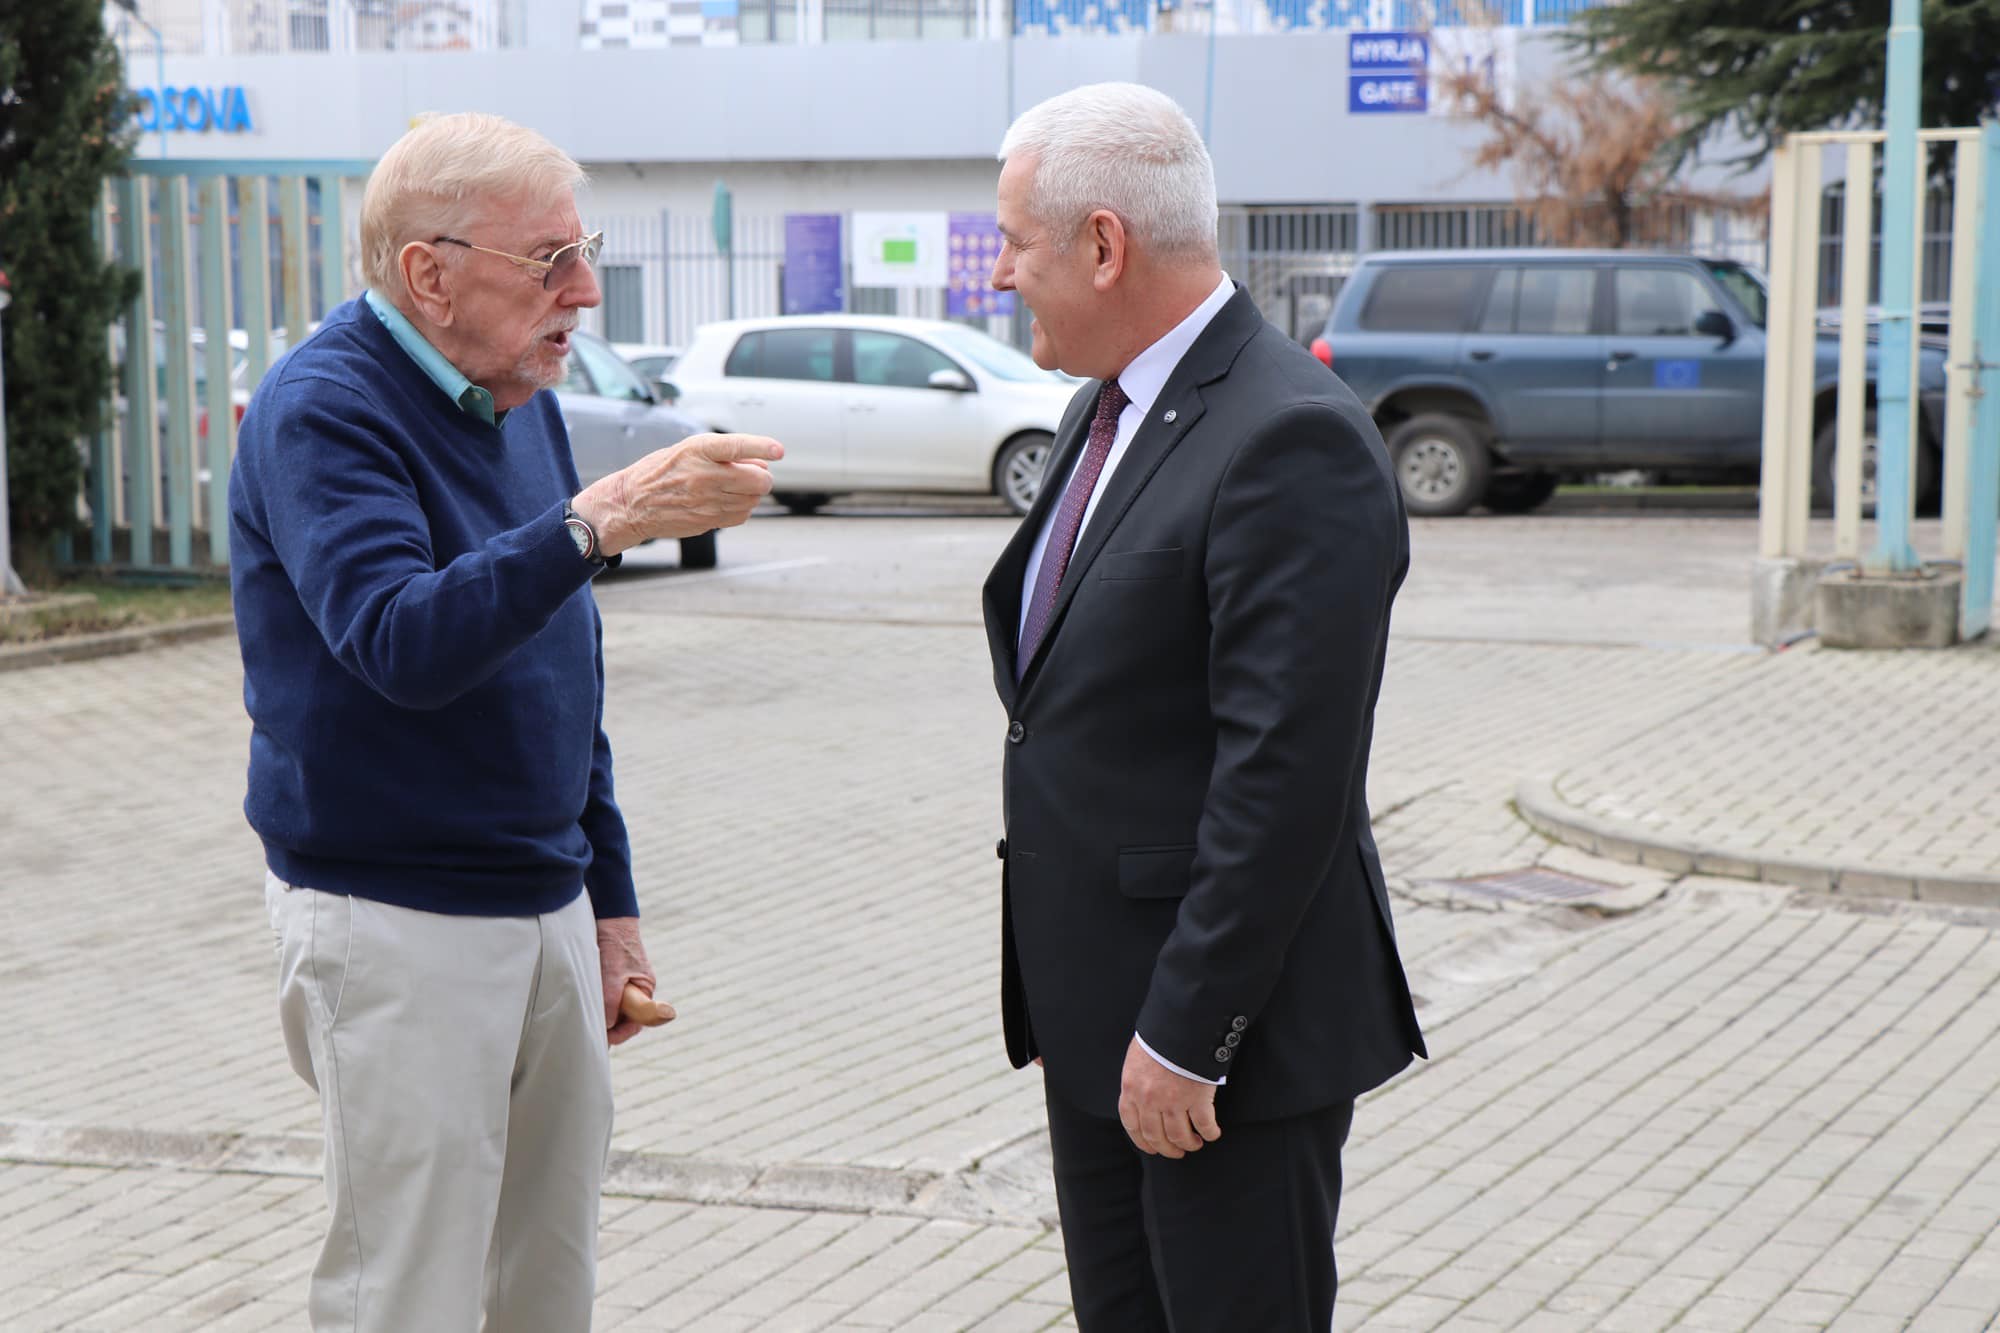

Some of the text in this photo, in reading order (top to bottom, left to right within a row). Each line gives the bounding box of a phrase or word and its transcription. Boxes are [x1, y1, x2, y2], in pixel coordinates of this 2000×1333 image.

[1353, 39, 1424, 62] HYRJA
[1359, 81, 1417, 104] GATE
[130, 86, 253, 132] OSOVA
